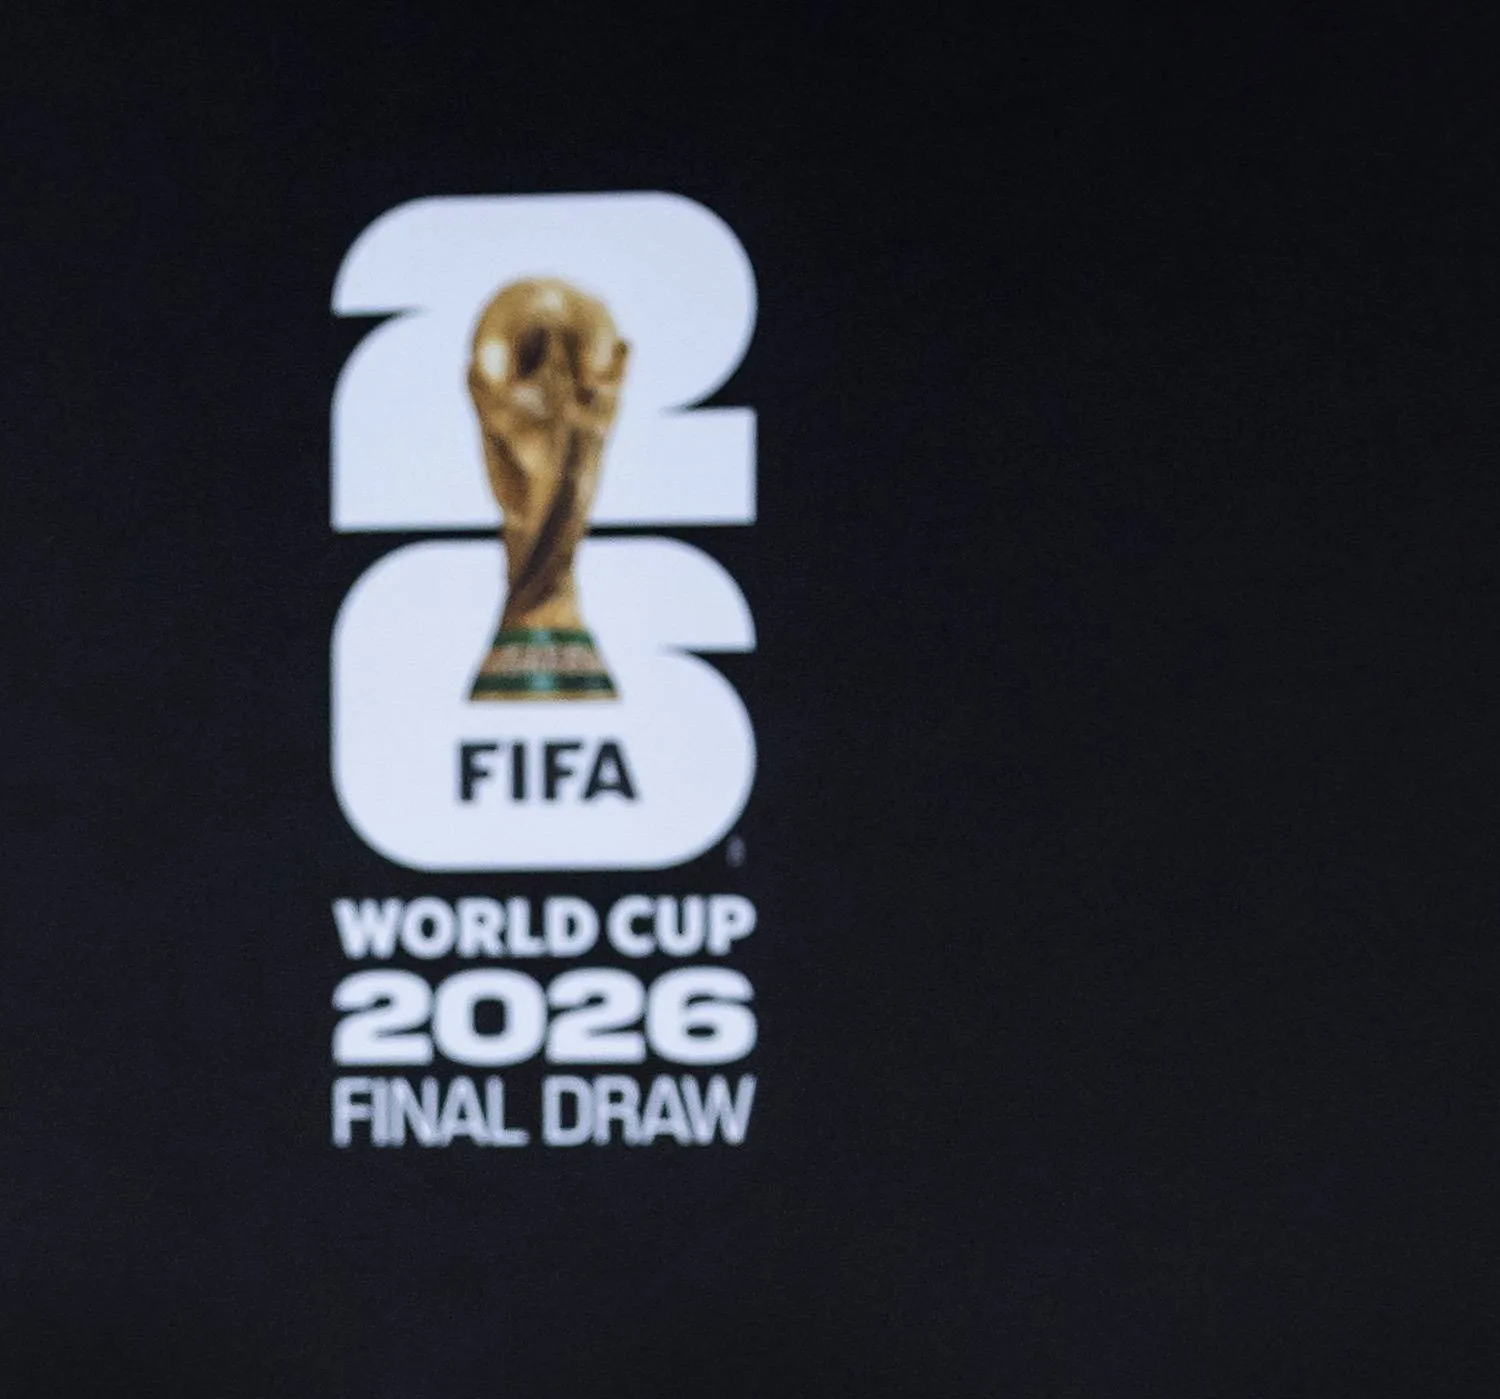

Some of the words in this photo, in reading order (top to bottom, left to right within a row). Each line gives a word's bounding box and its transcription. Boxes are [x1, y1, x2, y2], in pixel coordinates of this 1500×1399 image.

[458, 740, 638, 803] FIFA
[332, 896, 600, 960] WORLD
[606, 893, 758, 958] CUP
[331, 965, 758, 1067] 2026
[331, 1075, 530, 1148] FINAL
[541, 1074, 758, 1147] DRAW
